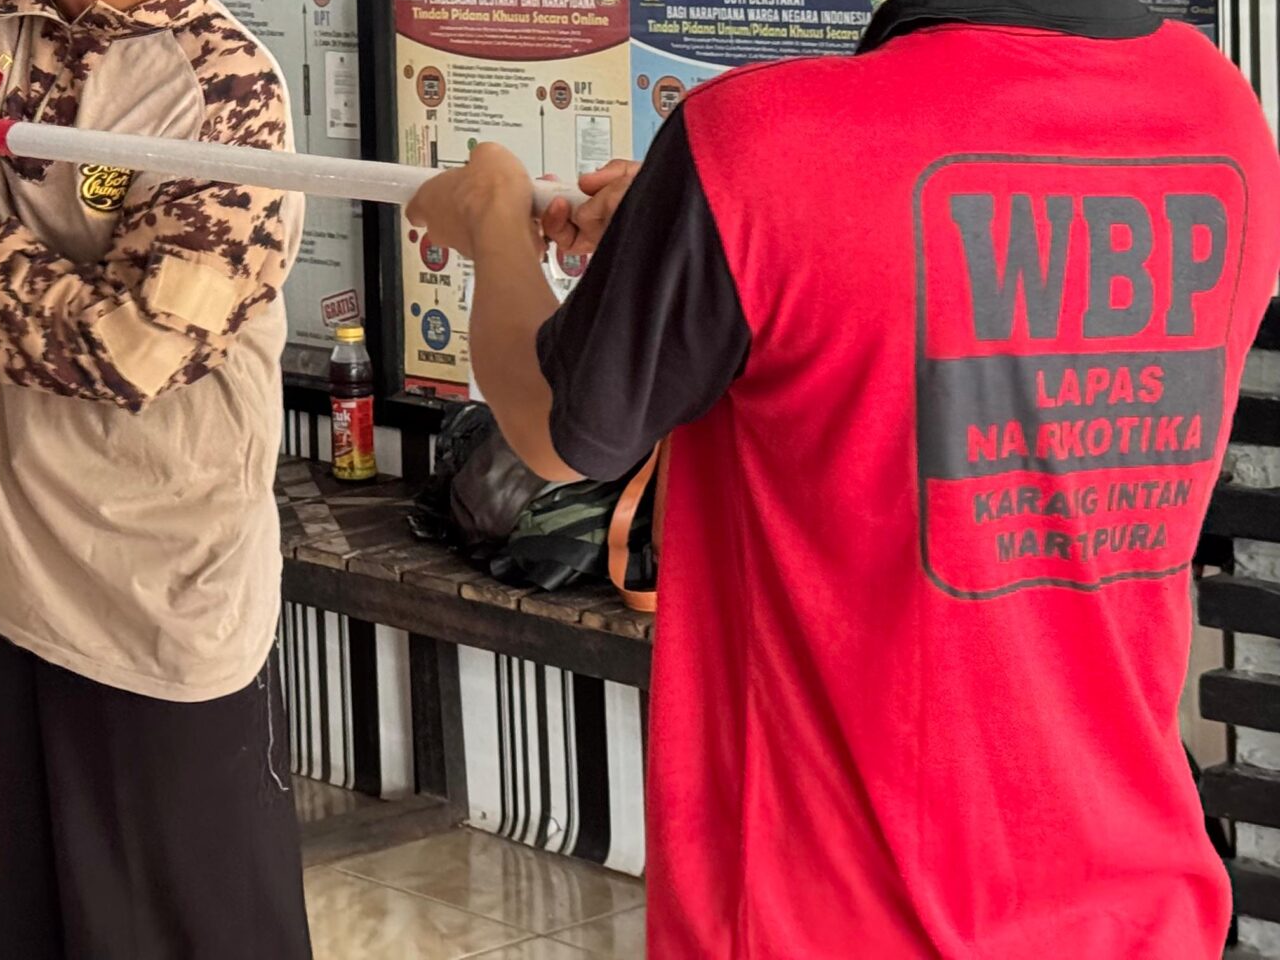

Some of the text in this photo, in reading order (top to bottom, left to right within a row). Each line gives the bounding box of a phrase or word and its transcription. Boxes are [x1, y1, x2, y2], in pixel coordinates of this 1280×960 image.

[412, 7, 609, 26] Tindak Pidana Khusus Secara Online
[666, 6, 872, 26] BAGI NARAPIDANA WARGA NEGARA INDONESIA
[648, 21, 679, 34] Tindak
[682, 22, 716, 36] Pidana
[790, 26, 823, 39] Khusus
[826, 27, 859, 40] Secara
[575, 81, 592, 95] UPT
[949, 192, 1228, 342] WBP
[324, 298, 356, 320] GRATIS
[1035, 365, 1165, 410] LAPAS
[967, 414, 1204, 464] NARKOTIKA
[1107, 478, 1193, 511] INTAN
